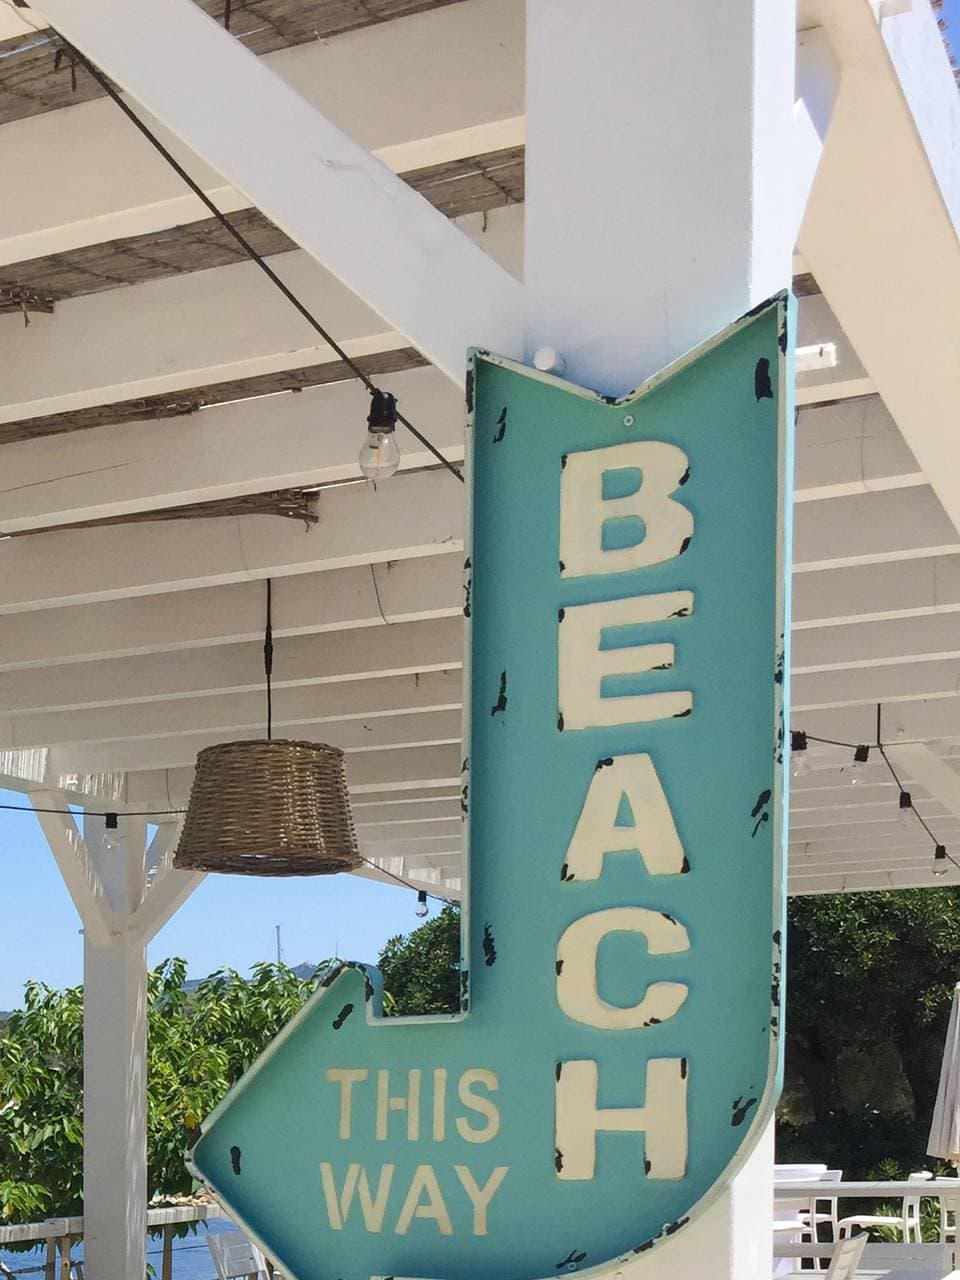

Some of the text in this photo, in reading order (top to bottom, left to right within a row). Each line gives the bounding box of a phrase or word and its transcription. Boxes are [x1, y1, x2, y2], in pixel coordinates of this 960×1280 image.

[555, 440, 694, 1181] BEACH
[326, 1067, 500, 1144] THIS
[319, 1162, 509, 1236] WAY
